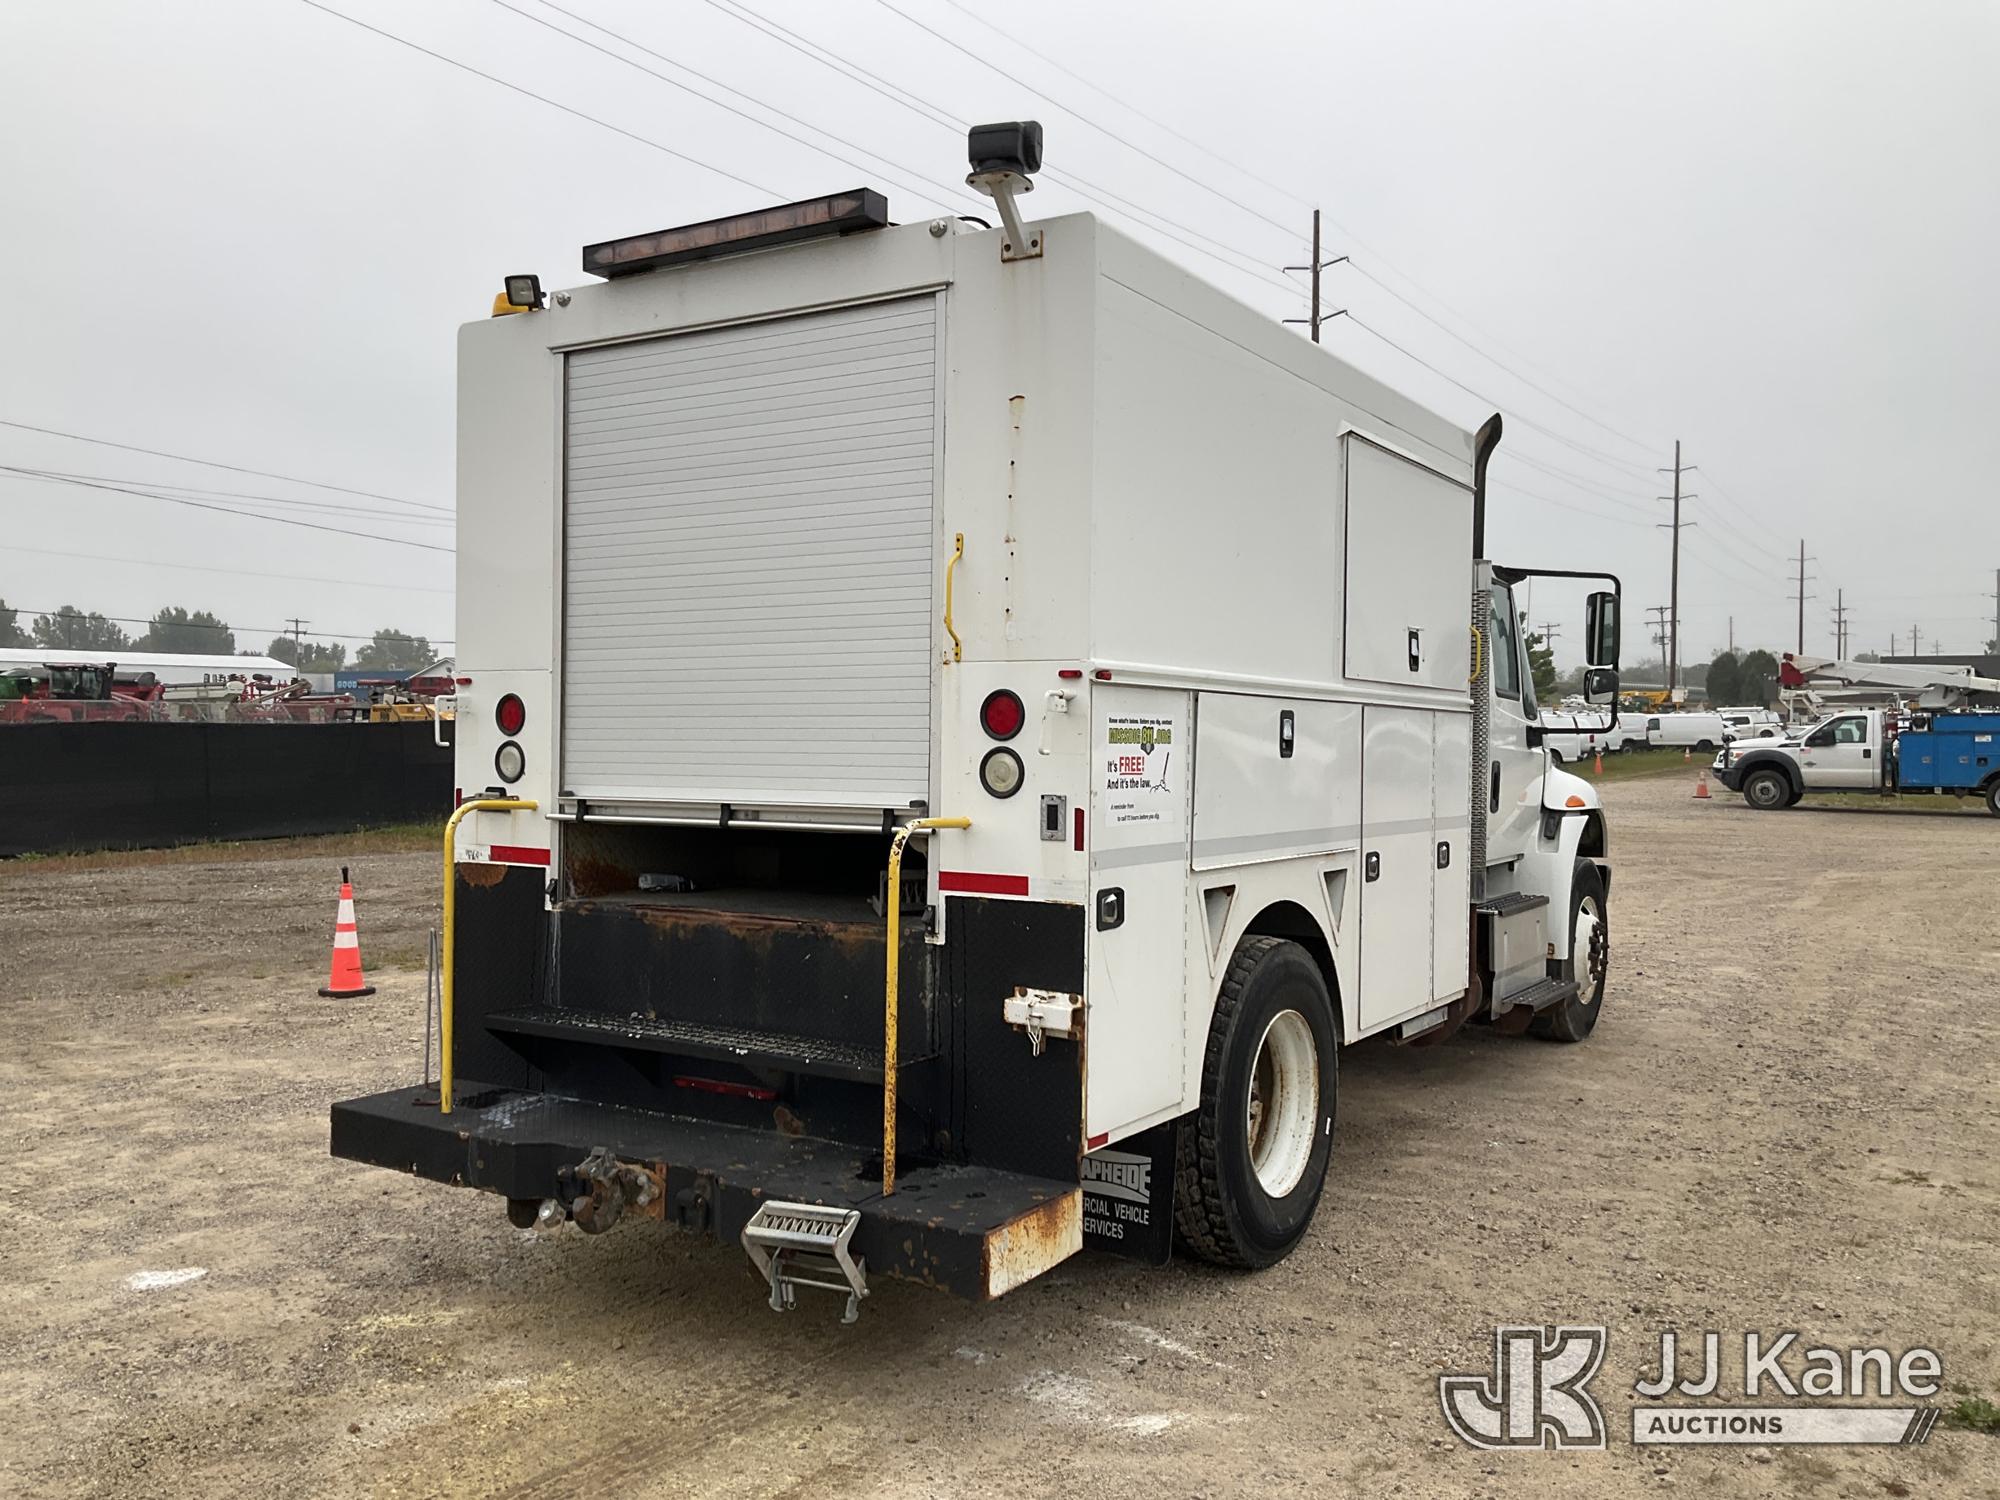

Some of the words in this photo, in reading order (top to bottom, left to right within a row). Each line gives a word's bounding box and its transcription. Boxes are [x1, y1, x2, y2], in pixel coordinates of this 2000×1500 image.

[1107, 760, 1118, 773] It's
[1119, 756, 1145, 773] FREE!
[1107, 778, 1119, 789] And
[1120, 779, 1129, 789] it's
[1129, 778, 1139, 789] the
[1140, 778, 1151, 788] law.
[1114, 1202, 1150, 1225] VEHICLE
